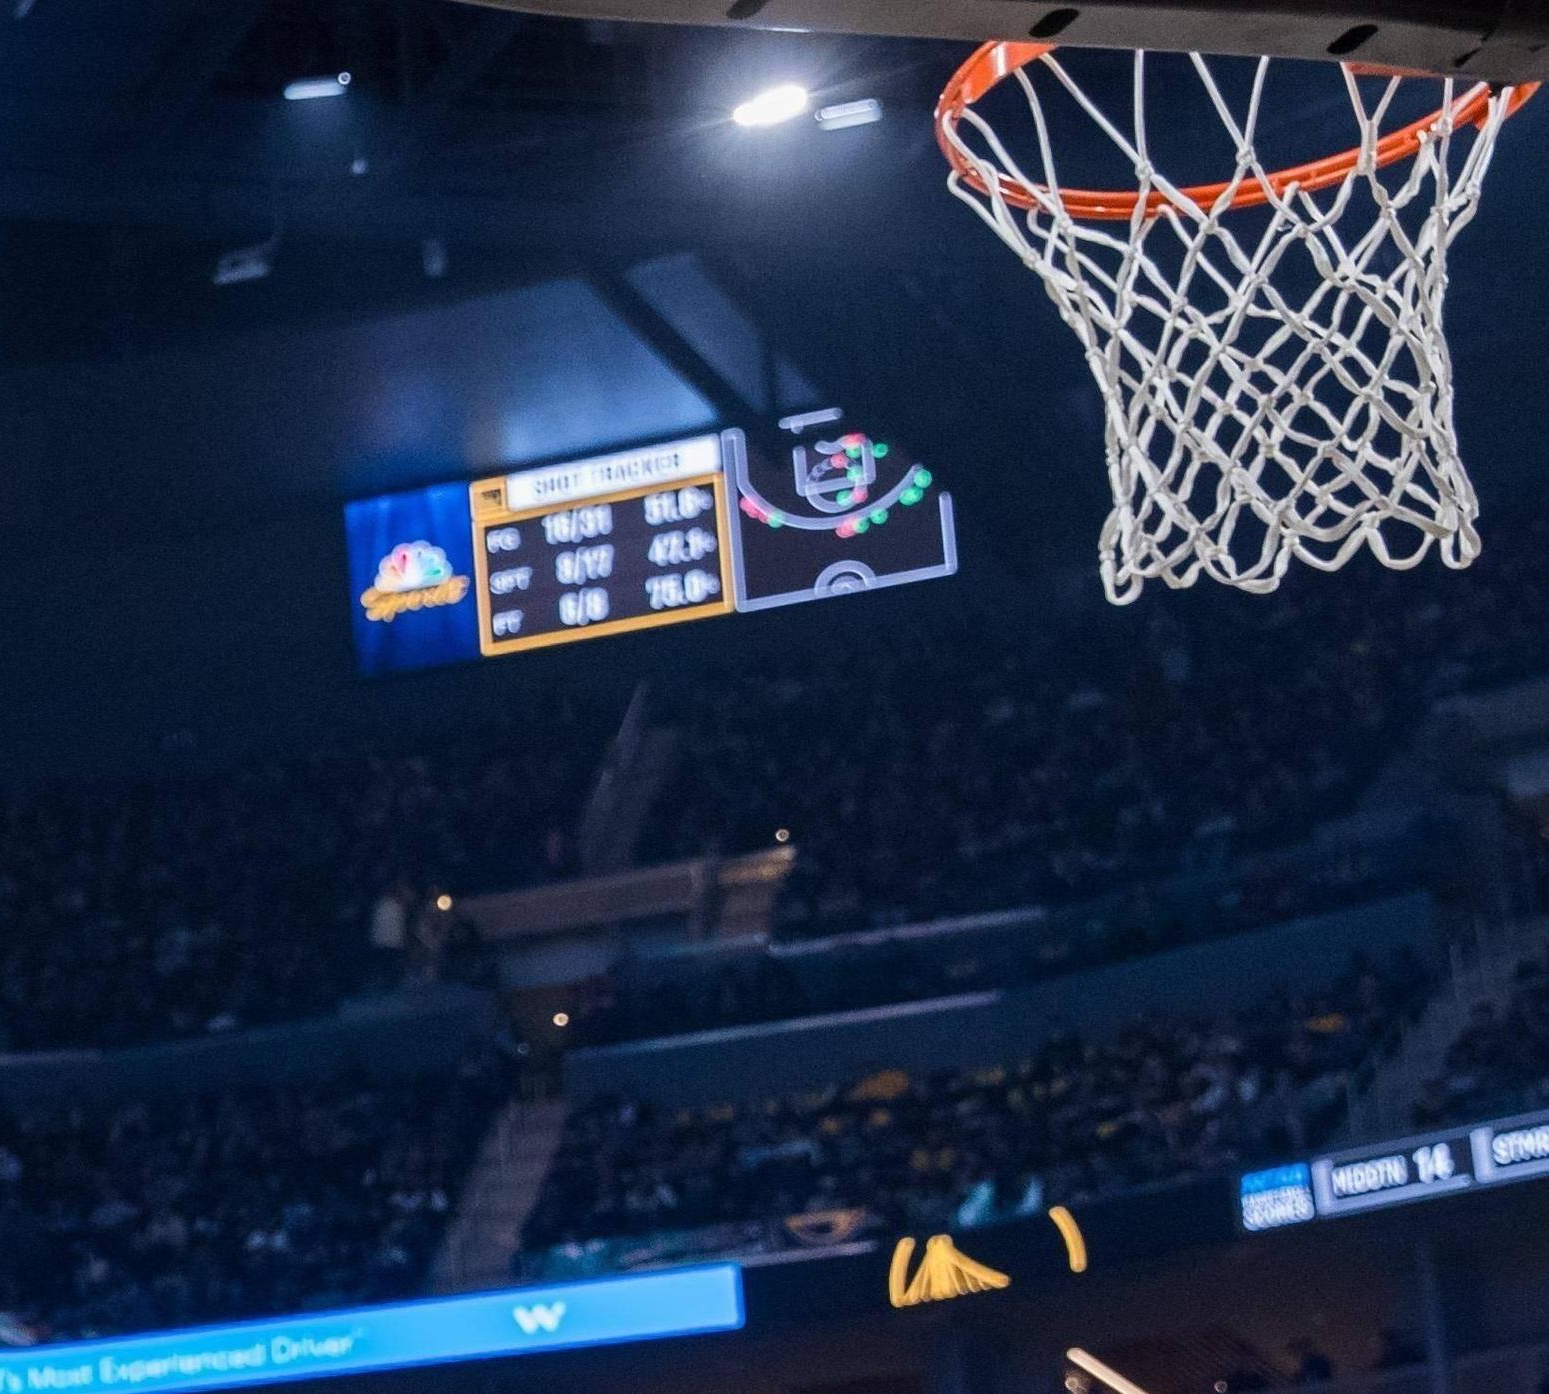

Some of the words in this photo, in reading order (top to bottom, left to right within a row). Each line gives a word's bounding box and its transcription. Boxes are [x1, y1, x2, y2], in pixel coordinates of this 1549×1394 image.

[532, 473, 580, 498] SHOT
[487, 527, 521, 554] FG
[493, 609, 525, 637] FT
[1412, 1142, 1455, 1184] 14
[27, 1364, 93, 1391] Most
[98, 1342, 267, 1385] Experienced
[270, 1334, 354, 1365] Driver
